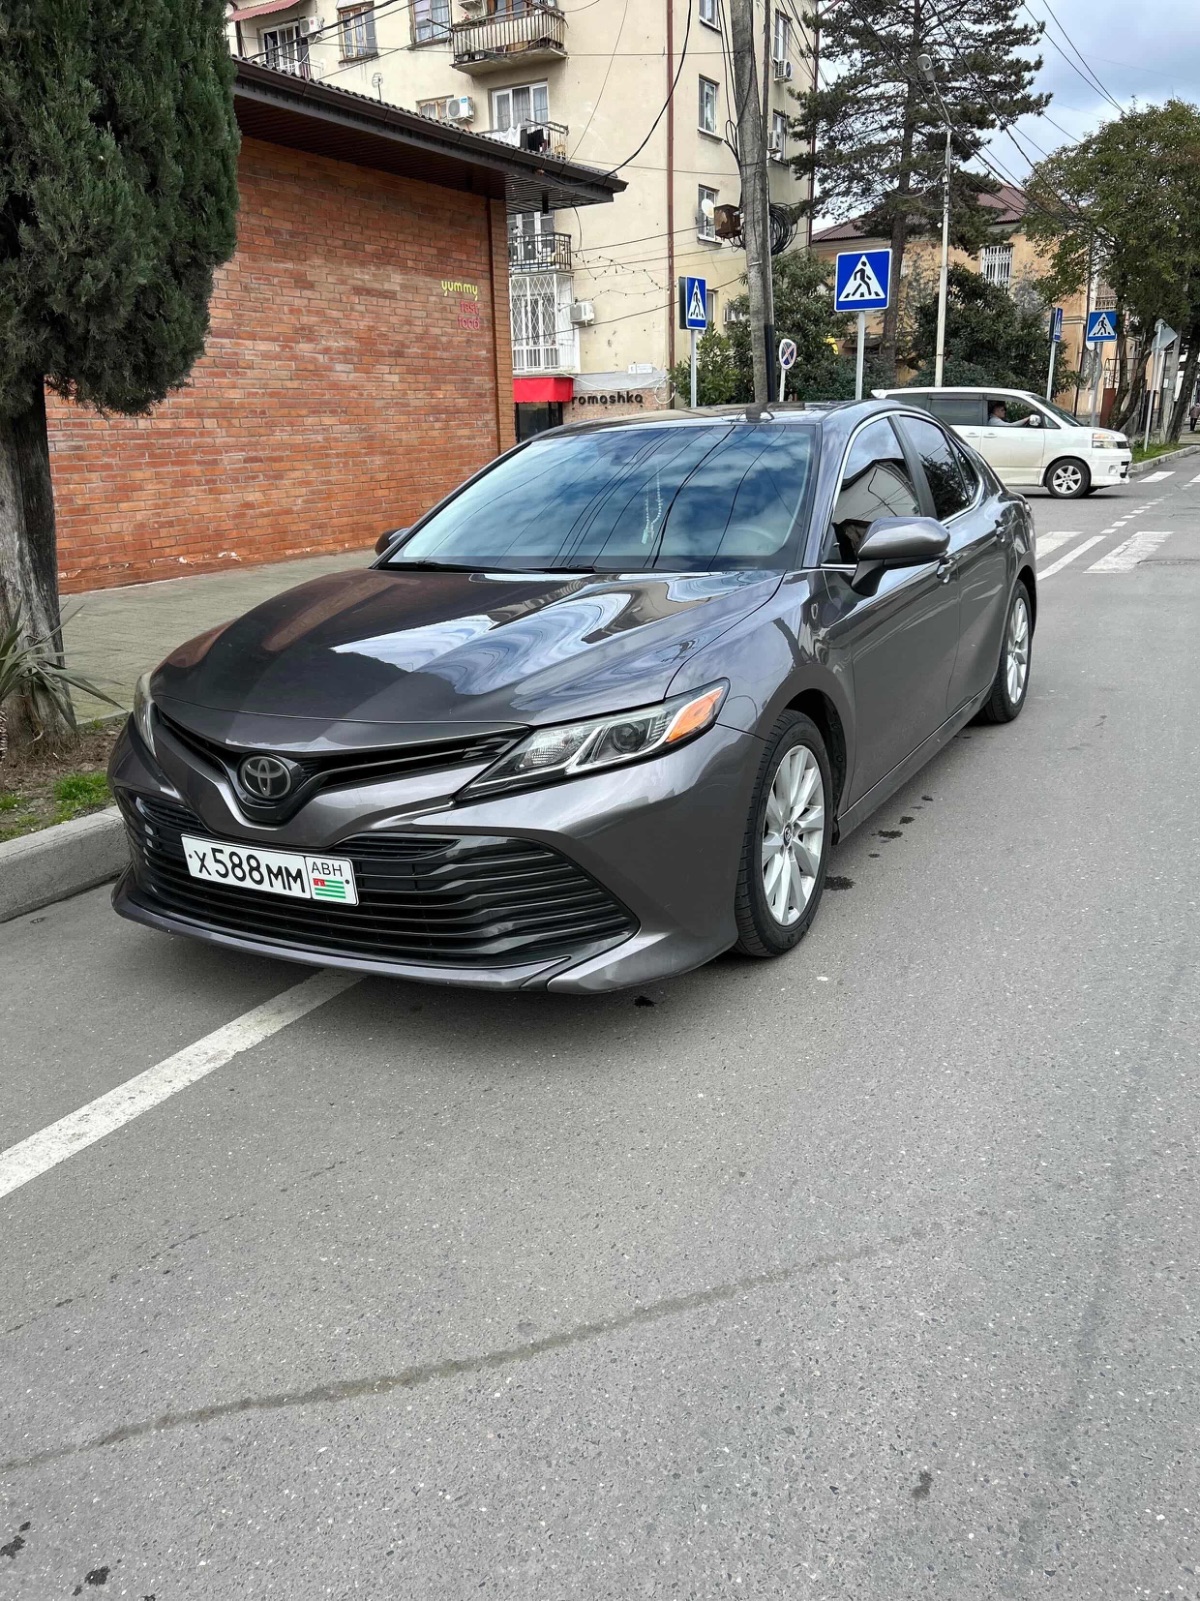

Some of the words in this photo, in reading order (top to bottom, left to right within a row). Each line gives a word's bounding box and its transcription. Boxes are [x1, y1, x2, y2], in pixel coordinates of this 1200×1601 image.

[441, 280, 478, 301] yummy
[457, 314, 480, 330] food
[571, 392, 643, 405] romashka
